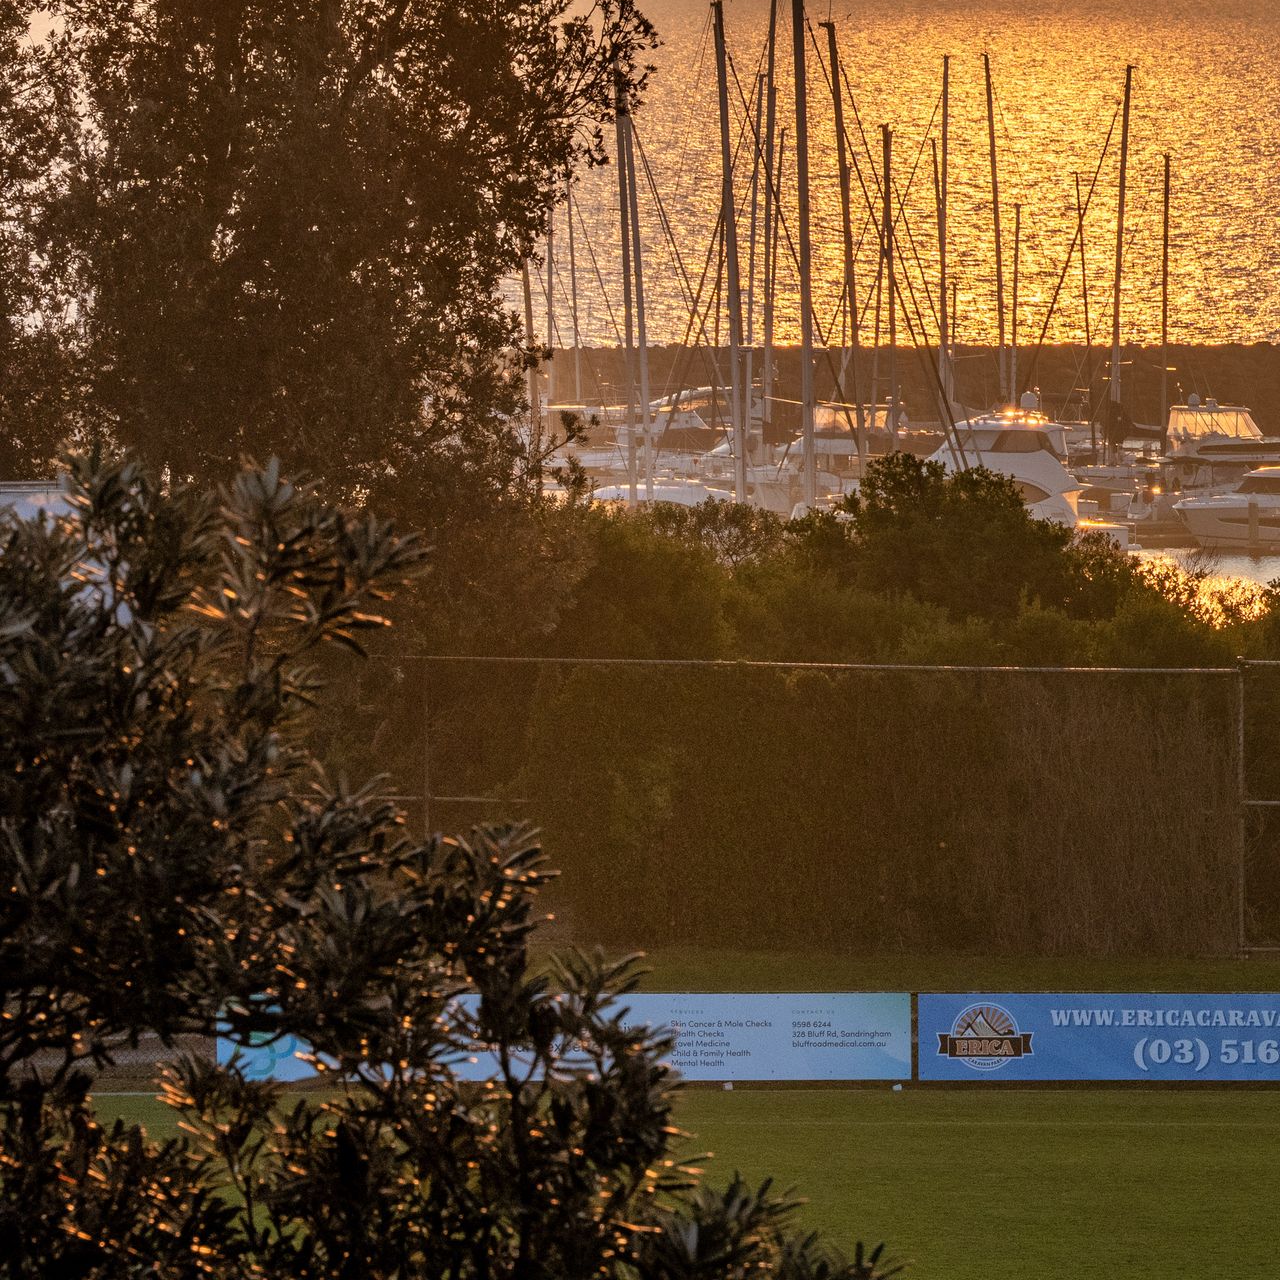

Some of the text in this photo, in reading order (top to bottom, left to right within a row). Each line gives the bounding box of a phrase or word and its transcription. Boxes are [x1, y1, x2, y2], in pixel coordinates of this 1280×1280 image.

[671, 1020, 687, 1028] Skin
[688, 1020, 716, 1028] Cancer
[745, 1020, 772, 1028] Checks
[697, 1030, 725, 1038] Checks
[807, 1030, 826, 1038] Bluff
[840, 1030, 892, 1040] Sandringham
[671, 1040, 731, 1048] ravel Medicine
[955, 1039, 1015, 1056] ERICA
[671, 1049, 691, 1057] Child
[700, 1049, 725, 1059] Family
[726, 1049, 751, 1057] Health
[1133, 1037, 1211, 1071] (03)
[700, 1059, 725, 1067] Health
